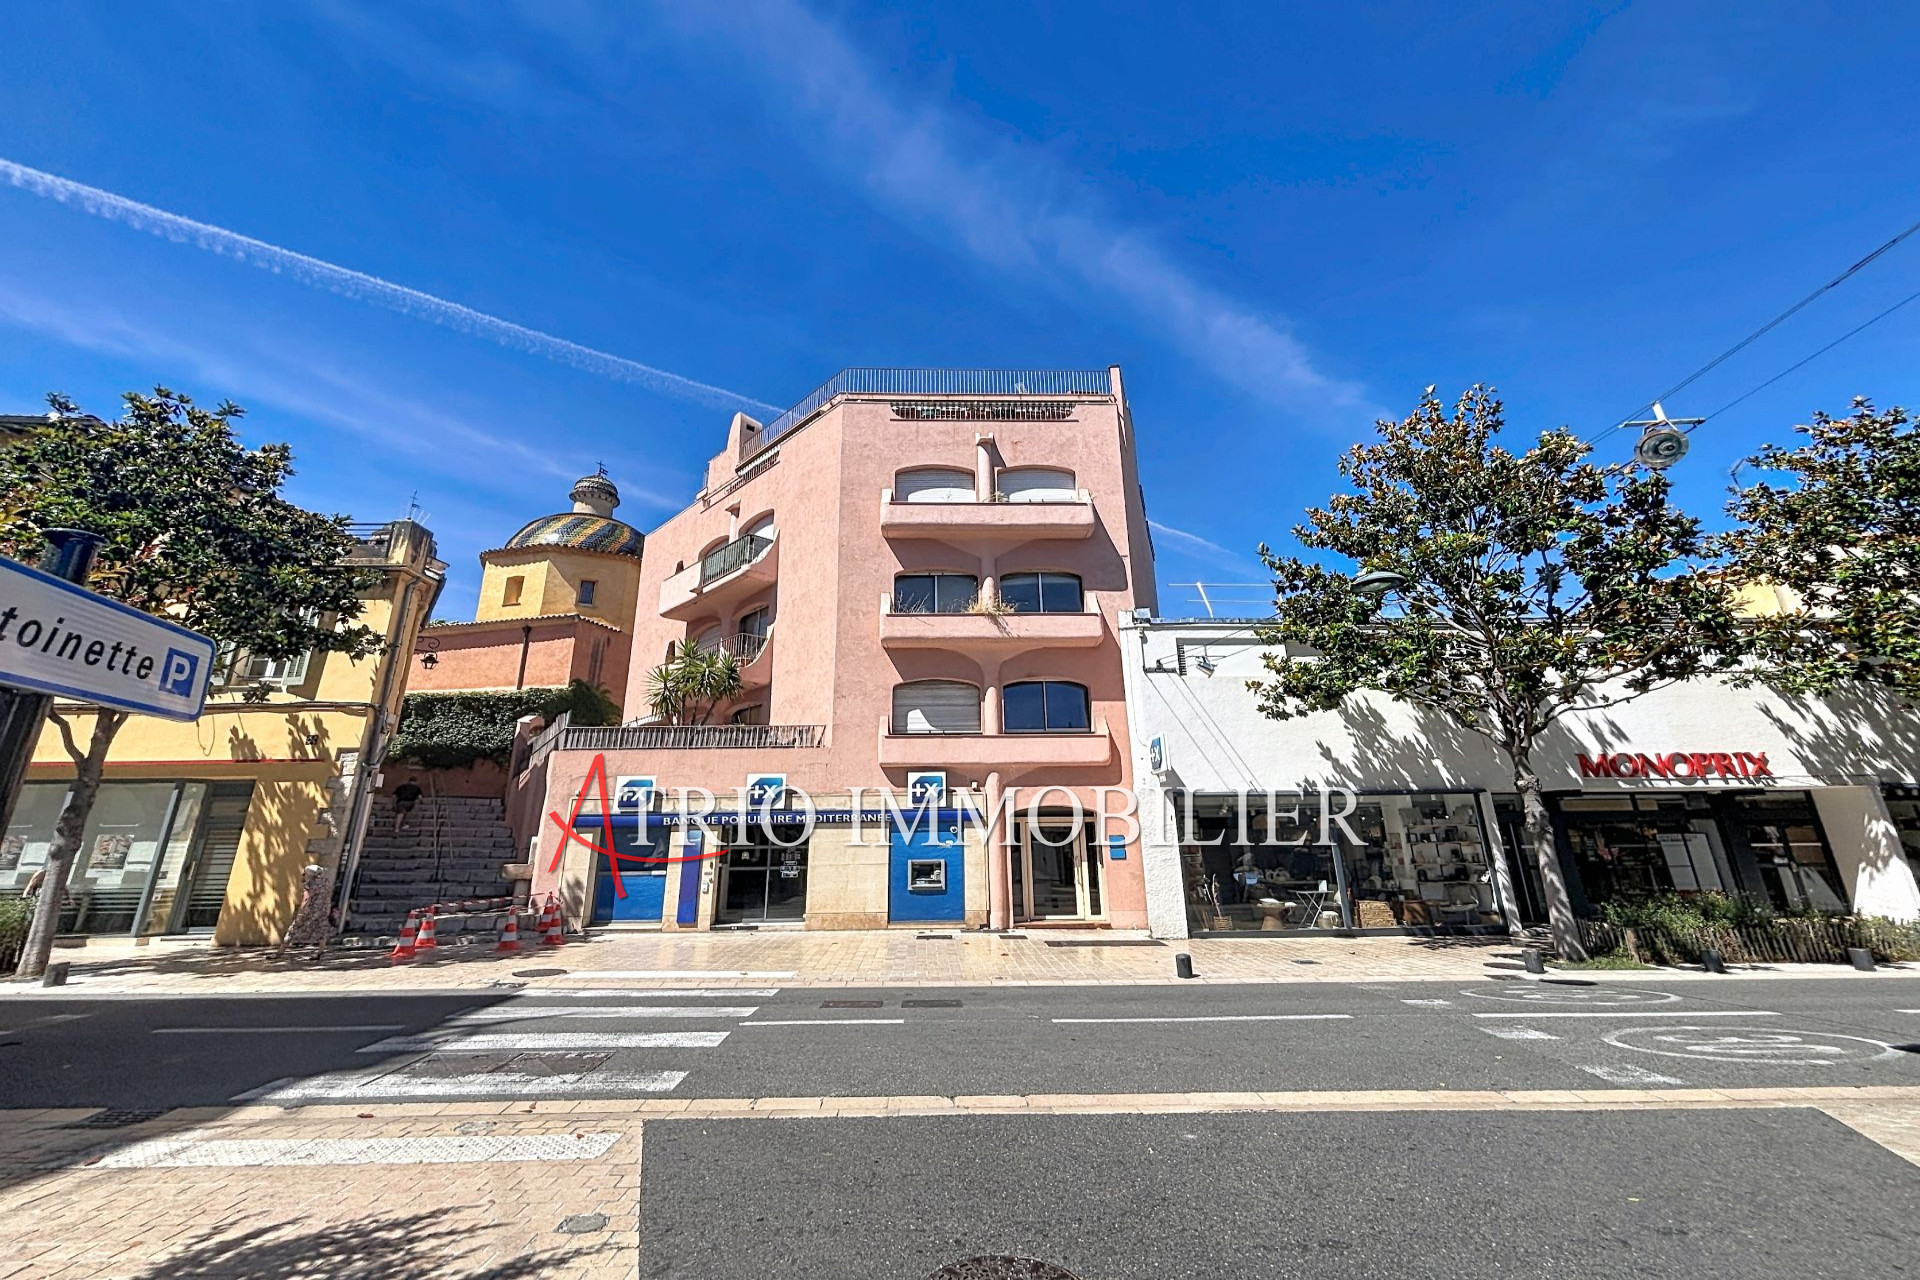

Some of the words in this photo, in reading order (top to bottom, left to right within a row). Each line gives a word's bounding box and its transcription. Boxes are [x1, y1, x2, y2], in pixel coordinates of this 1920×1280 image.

[0, 606, 154, 680] toinette
[166, 654, 191, 689] P
[1575, 751, 1774, 778] MONOPRIX
[663, 816, 718, 826] BANQUE
[722, 815, 793, 825] POPULAIRE
